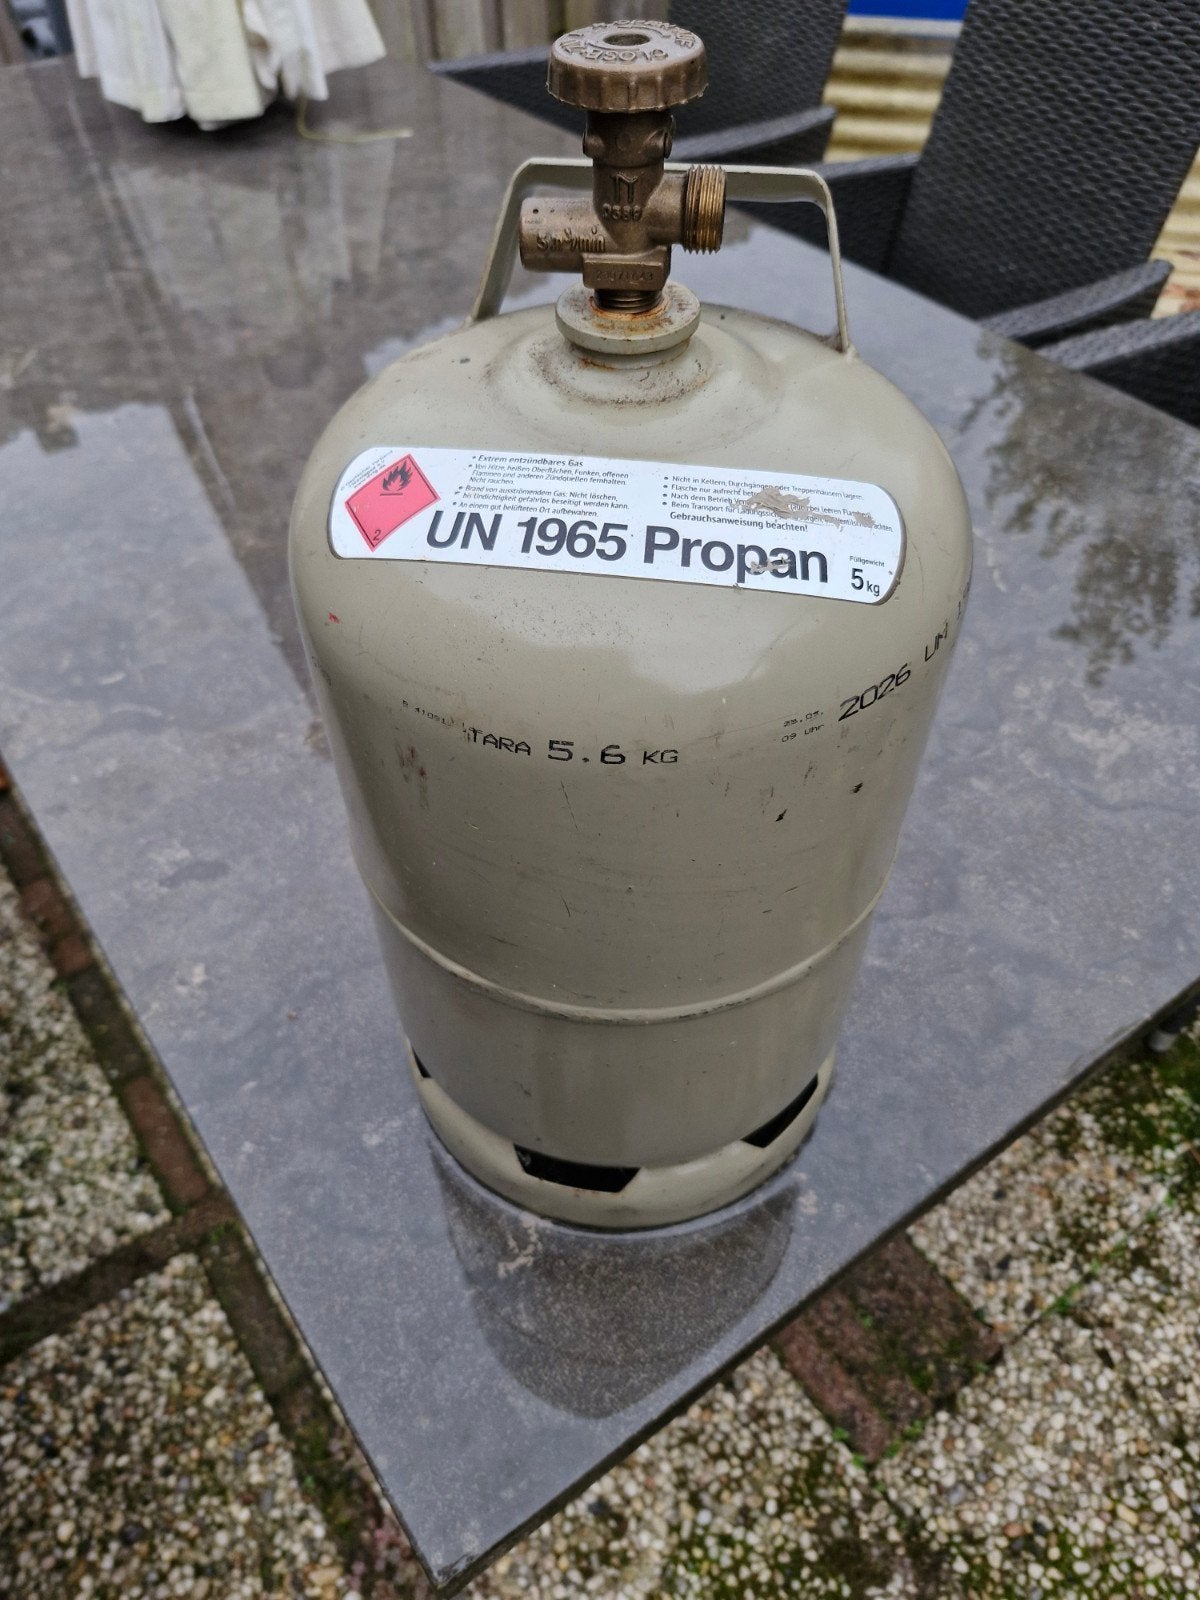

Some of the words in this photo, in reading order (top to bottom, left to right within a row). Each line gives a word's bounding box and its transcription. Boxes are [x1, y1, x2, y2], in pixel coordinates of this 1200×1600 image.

[478, 454, 507, 463] Extrem
[509, 457, 566, 467] entzündbares
[568, 459, 584, 467] Gas
[472, 469, 501, 478] Flammen
[545, 474, 588, 483] Zündquellen
[507, 465, 530, 473] heißen
[574, 469, 601, 477] Funken,
[602, 471, 629, 479] offenen
[701, 478, 728, 486] Kellern,
[465, 485, 485, 493] Brand
[569, 491, 588, 499] Nicht
[671, 483, 698, 491] Flasche
[712, 487, 741, 496] aufrecht
[469, 502, 489, 510] einem
[502, 504, 538, 512] belüfteten
[539, 506, 551, 514] Ort
[473, 493, 517, 502] Undichtigkeit
[517, 496, 550, 504] gefahrlos
[551, 498, 581, 506] beseitigt
[610, 502, 630, 510] kann.
[670, 492, 689, 501] Nach
[707, 495, 733, 505] Betrieb
[820, 505, 841, 515] leeren
[671, 501, 689, 509] Beim
[691, 502, 724, 512] Transport
[725, 505, 736, 513] für
[670, 511, 764, 530] Gebrauchsanweisung
[765, 520, 808, 533] beachten!
[373, 529, 382, 541] 2
[427, 510, 503, 551] UN
[517, 516, 629, 562] 1965
[643, 525, 829, 584] Propan
[849, 555, 885, 567] Füllgewicht
[851, 567, 864, 591] 5
[866, 580, 880, 597] kg
[838, 662, 912, 722] 2026
[470, 727, 532, 756] TARA
[547, 739, 626, 765] 5.6
[642, 749, 679, 766] KG
